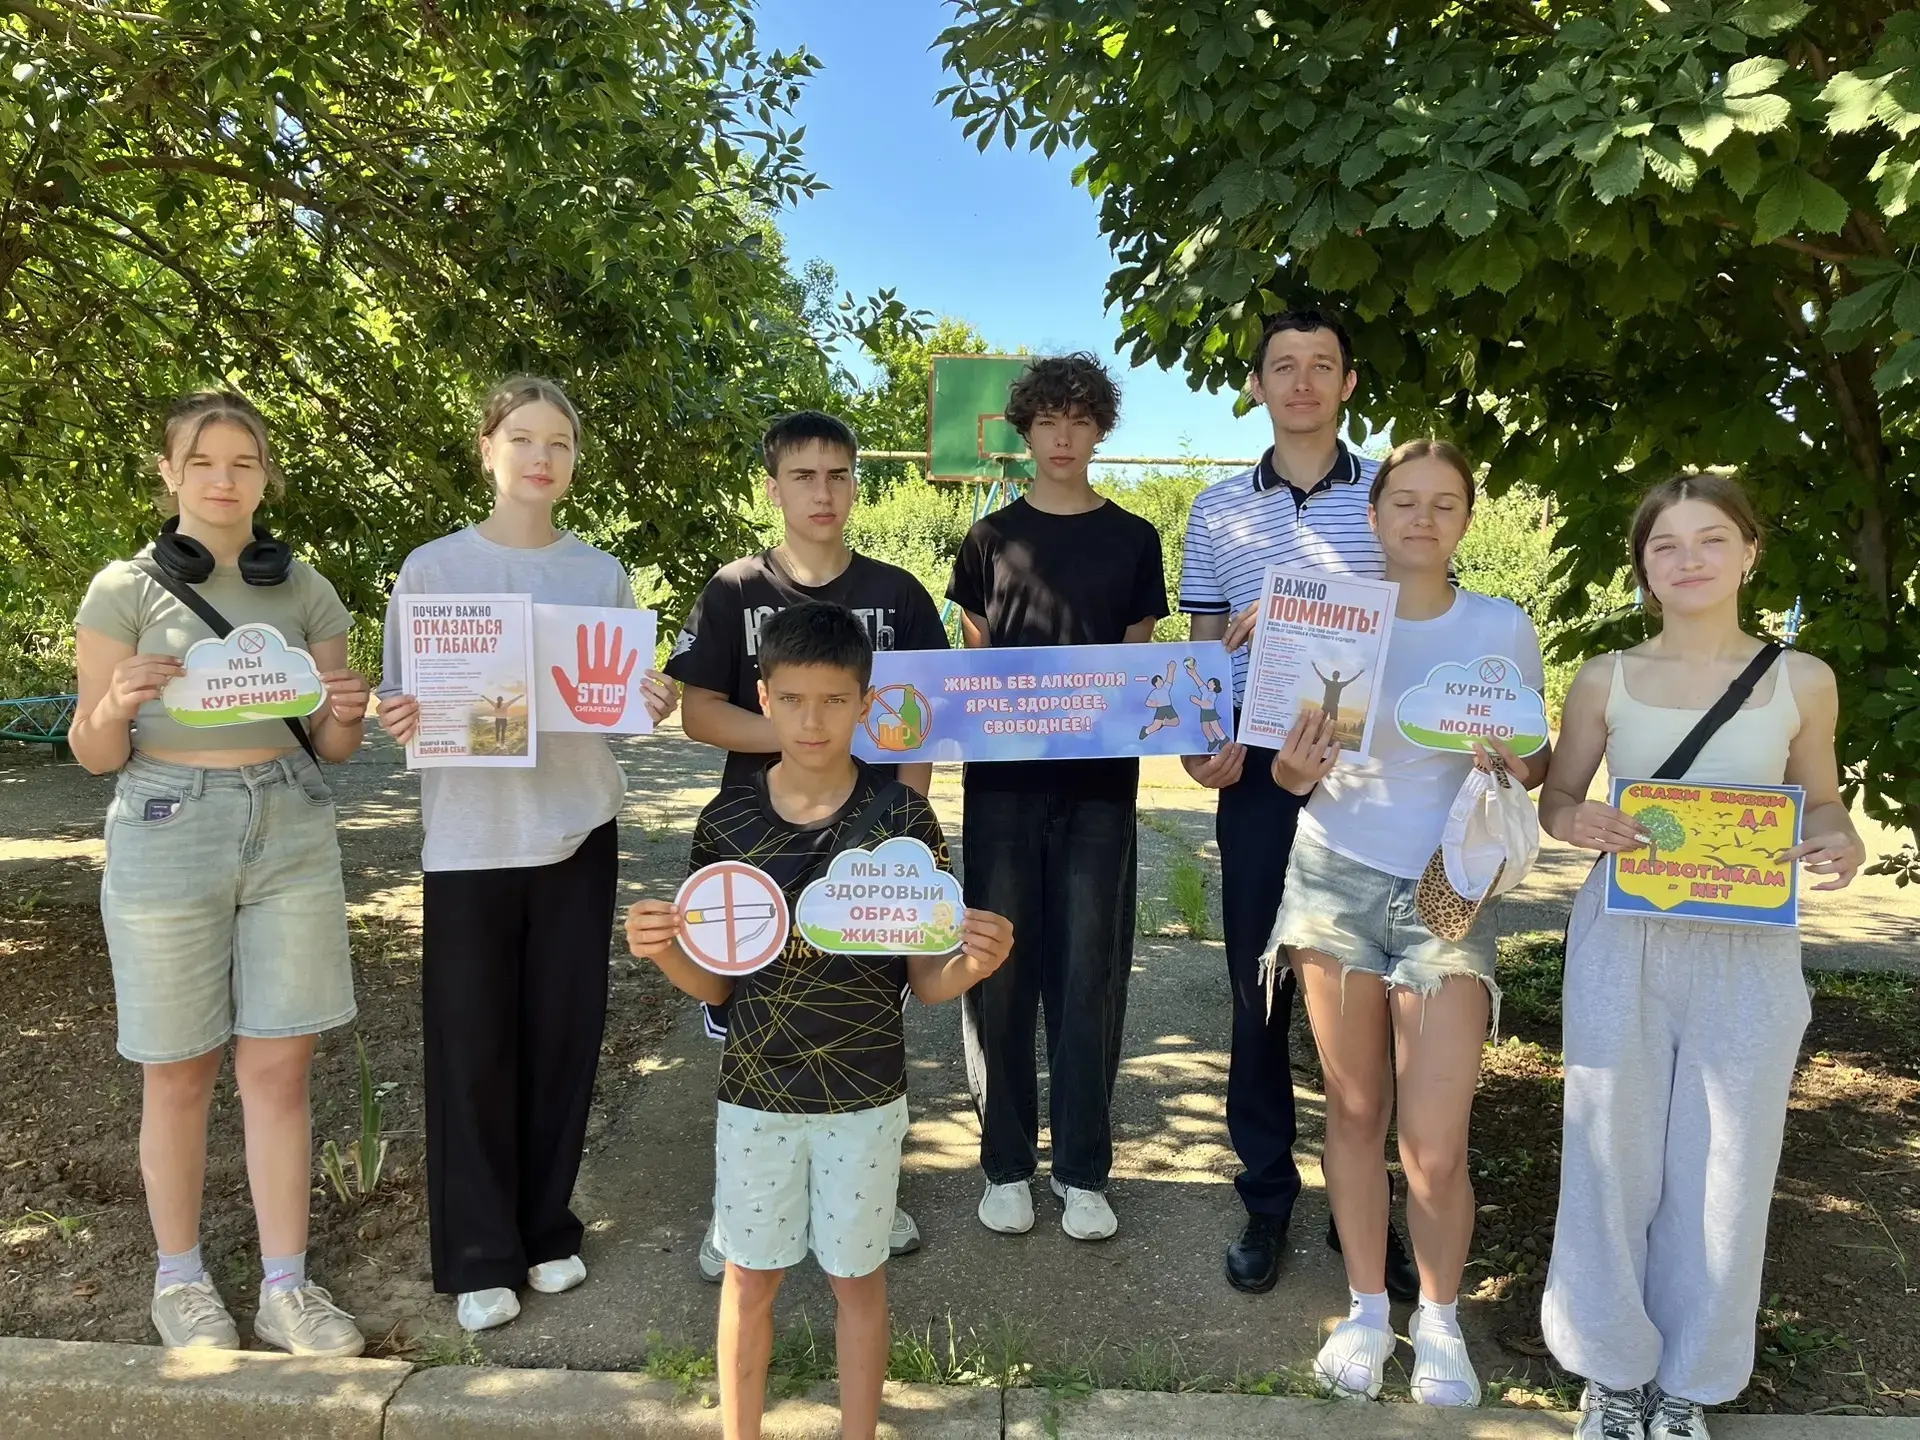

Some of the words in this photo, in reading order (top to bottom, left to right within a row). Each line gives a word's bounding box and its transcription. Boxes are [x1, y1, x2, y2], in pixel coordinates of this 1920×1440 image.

[1273, 576, 1327, 600] ВАЖНО
[412, 605, 452, 618] ПОЧЕМУ
[455, 605, 491, 617] ВАЖНО
[1269, 596, 1380, 635] ПОМНИТЬ!
[413, 619, 502, 636] ОТКАЗАТЬСЯ
[414, 637, 433, 654] ОТ
[435, 637, 497, 654] ТАБАКА?
[228, 656, 262, 671] МЫ
[207, 672, 288, 691] ПРОТИВ
[944, 677, 1003, 692] ЖИЗНЬ
[1006, 675, 1036, 690] БЕЗ
[1040, 672, 1128, 689] АЛКОГОЛЯ
[201, 689, 298, 709] КУРЕНИЯ!
[577, 683, 625, 705] STOP
[1445, 682, 1517, 702] КУРИТЬ
[575, 705, 622, 713] СИГАРЕТАМ!
[965, 697, 1014, 713] ЯРЧЕ,
[1017, 694, 1108, 711] ЗДОРОВЕЕ,
[1466, 703, 1492, 717] НЕ
[1250, 724, 1276, 734] ВЫБИРАЙ
[1278, 728, 1288, 736] СЕБ
[1439, 718, 1515, 738] МОДНО!
[1629, 785, 1701, 801] СКАЖИ
[1710, 791, 1788, 809] ЖИЗНИ
[1737, 808, 1779, 829] ДА
[850, 862, 887, 878] МЫ
[893, 862, 920, 878] ЗА
[1619, 857, 1786, 887] НАРКОТИКАМ
[824, 882, 944, 901] ЗДОРОВЫЙ
[1690, 882, 1733, 899] НЕТ
[849, 906, 918, 922] ОБРАЗ
[840, 928, 925, 944] ЖИЗНИ!
